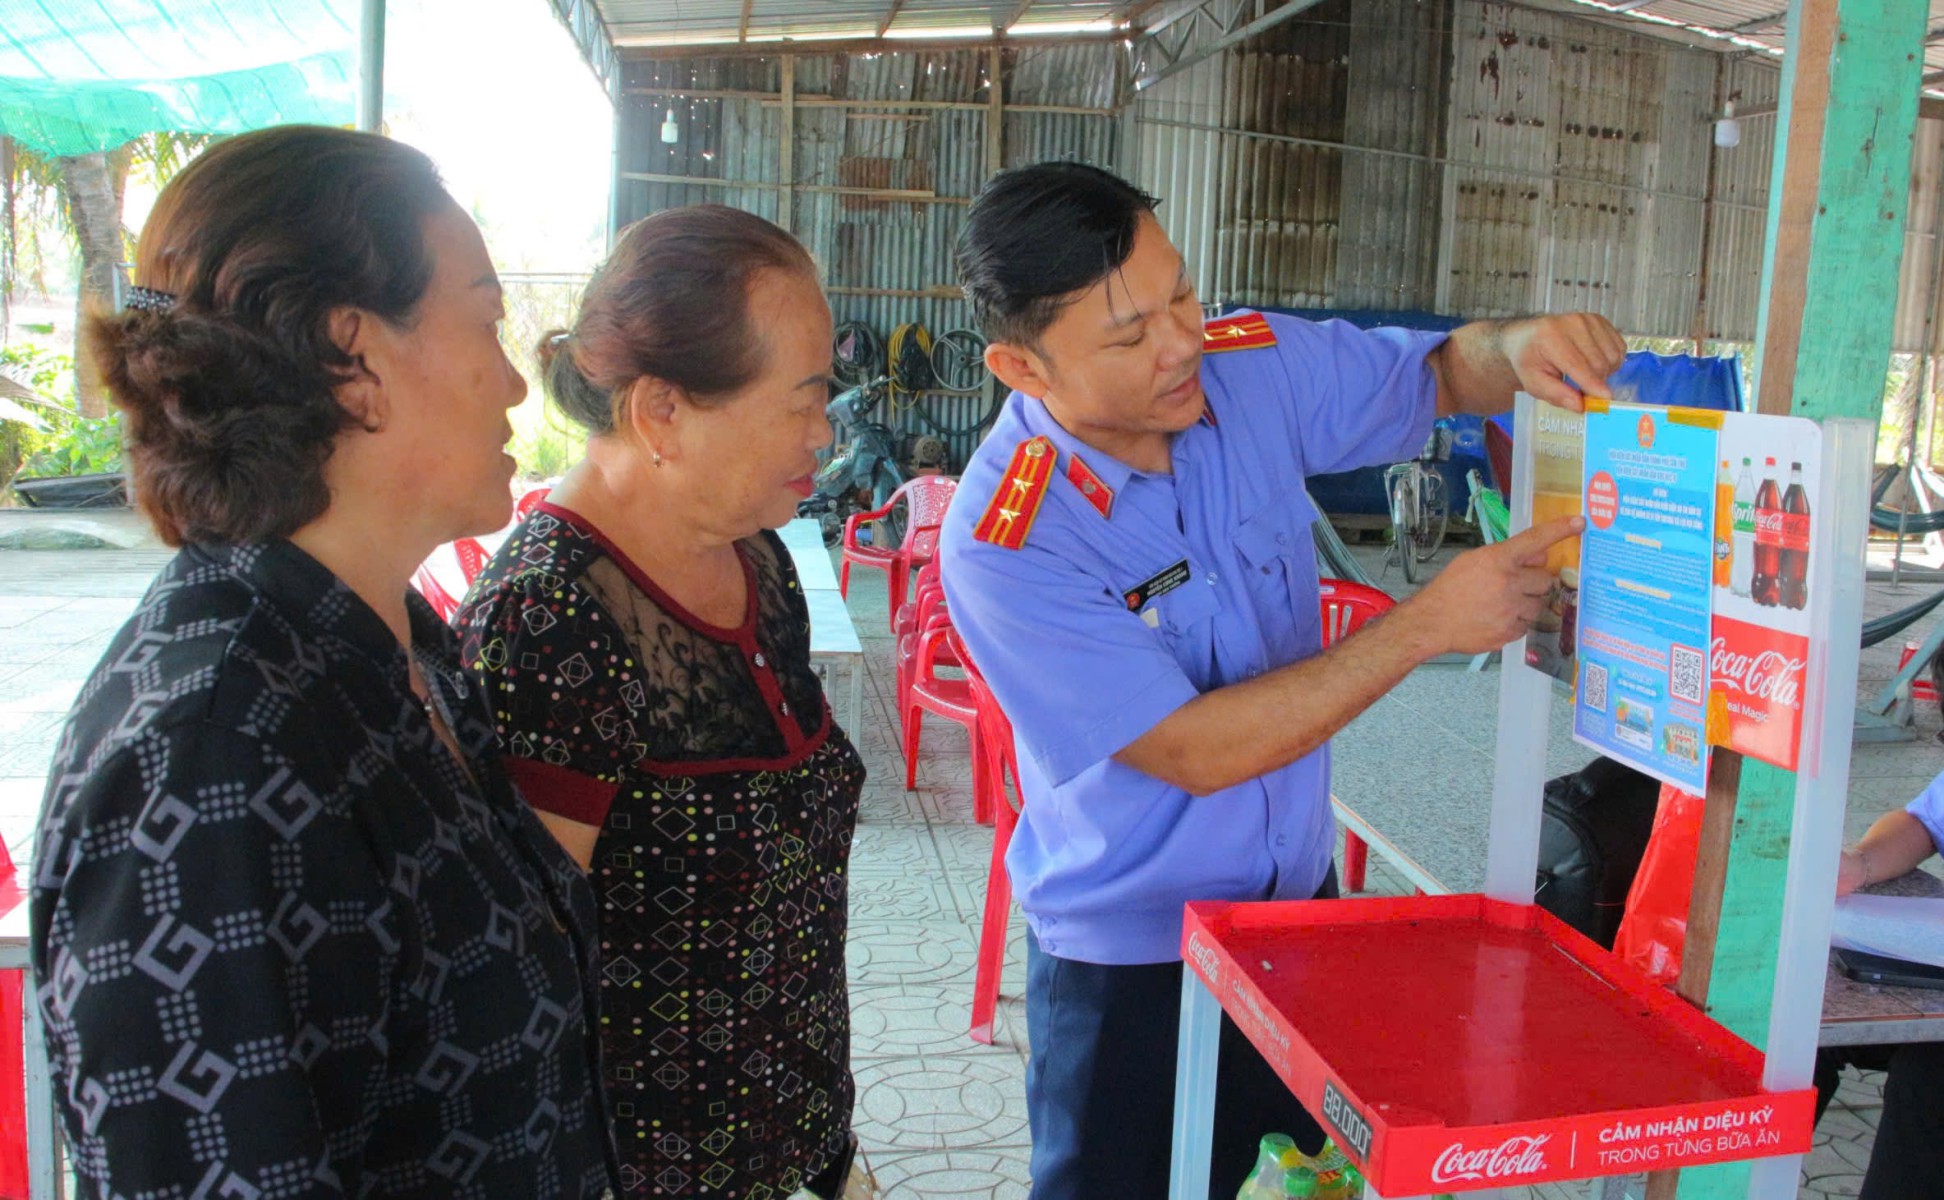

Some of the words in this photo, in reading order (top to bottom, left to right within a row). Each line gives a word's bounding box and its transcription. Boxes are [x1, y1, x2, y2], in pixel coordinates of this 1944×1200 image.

[1727, 701, 1740, 714] eal
[1741, 704, 1769, 722] Magic
[1599, 1122, 1641, 1143] CẢM
[1645, 1117, 1699, 1138] NHẬN
[1703, 1110, 1745, 1131] DIỆU
[1598, 1144, 1660, 1166] TRONG
[1665, 1136, 1712, 1157] TỪNG
[1716, 1131, 1751, 1150] BỮA
[1755, 1130, 1781, 1146] ĂN
